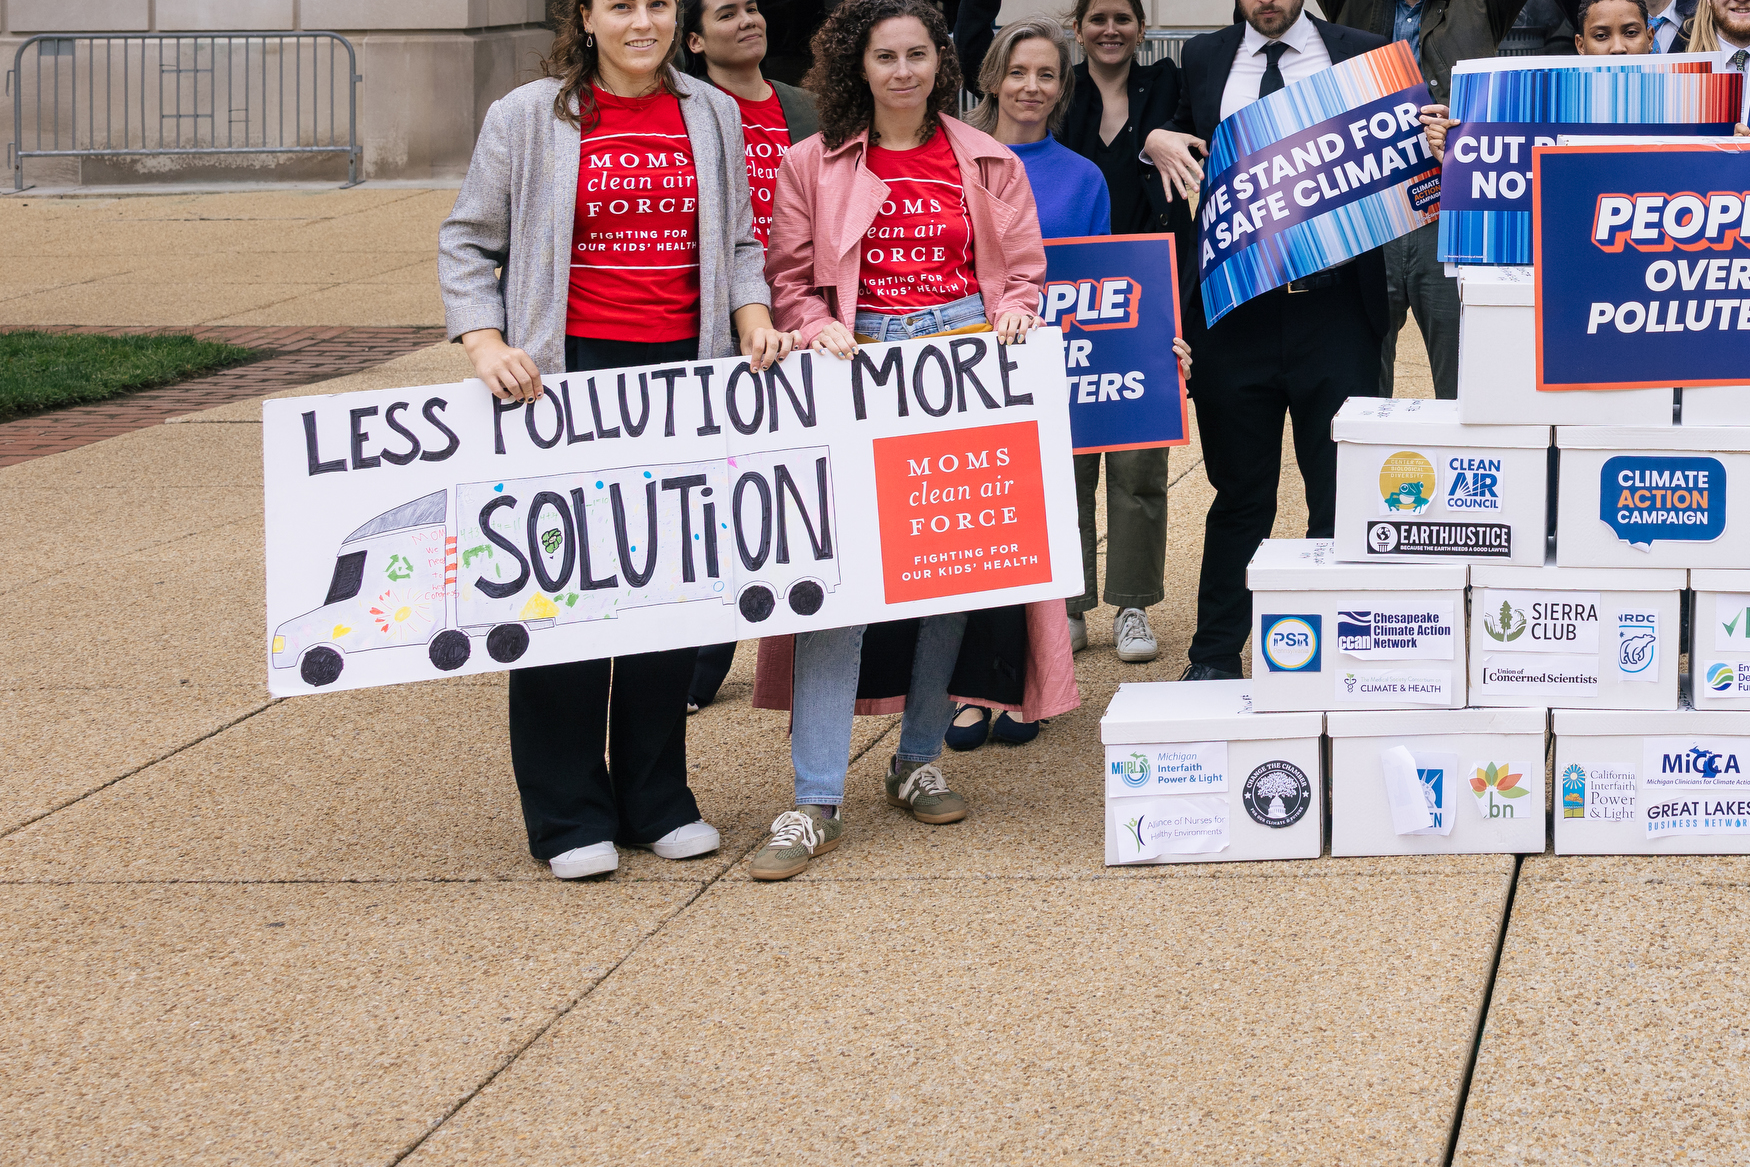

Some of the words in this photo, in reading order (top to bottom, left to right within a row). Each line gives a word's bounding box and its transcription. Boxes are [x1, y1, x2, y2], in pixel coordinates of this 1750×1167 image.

[1453, 137, 1525, 164] CUT
[588, 152, 688, 169] MOMS
[1202, 184, 1232, 231] WE
[1233, 133, 1345, 199] STAND
[1349, 102, 1421, 149] FOR
[587, 171, 652, 192] clean
[663, 171, 694, 188] air
[587, 198, 696, 217] FORCE
[591, 230, 657, 240] FIGHTING
[664, 230, 688, 238] FOR
[915, 220, 946, 238] air
[1202, 238, 1216, 270] A
[1216, 191, 1290, 249] SAFE
[578, 243, 605, 251] OUR
[657, 241, 696, 251] HEALTH
[301, 396, 460, 477] LESS
[492, 352, 817, 455] POLLUTION
[850, 334, 1036, 422] MORE
[907, 447, 1010, 477] MOMS
[1449, 458, 1501, 472] CLEAN
[1448, 472, 1499, 497] AIR
[1618, 470, 1709, 487] CLIMATE
[909, 481, 970, 507] clean
[980, 475, 1014, 498] air
[1617, 489, 1708, 509] ACTION
[1448, 498, 1499, 509] COUNCIL
[909, 507, 1018, 536] FORCE
[1617, 510, 1708, 524] CAMPAIGN
[1401, 525, 1508, 546] EARTHJUSTICE
[914, 548, 984, 565] FIGHTING
[991, 544, 1019, 555] FOR
[902, 569, 931, 581] OUR
[984, 555, 1038, 570] HEALTH
[1374, 613, 1439, 625] Chesapeake
[1532, 603, 1598, 621] SIERRA
[1374, 625, 1416, 636] Climate
[1417, 625, 1450, 636] Action
[1531, 624, 1577, 640] CLUB
[1374, 637, 1417, 649] Network
[1489, 673, 1546, 683] Concerned
[1547, 673, 1597, 684] Scientists
[1408, 685, 1441, 693] HEALTH
[1158, 752, 1197, 763] Michigan
[1662, 753, 1740, 774] MiCCA
[1158, 764, 1202, 773] Interfaith
[1591, 770, 1635, 779] California
[1158, 776, 1187, 784] Power
[1198, 774, 1223, 784] Light
[1591, 781, 1635, 791] Interfaith
[1703, 778, 1712, 786] for
[1591, 792, 1635, 805] Power
[1590, 809, 1601, 818] &
[1604, 807, 1634, 820] Light
[1648, 802, 1700, 819] GREAT
[1648, 818, 1698, 831] BUSINESS
